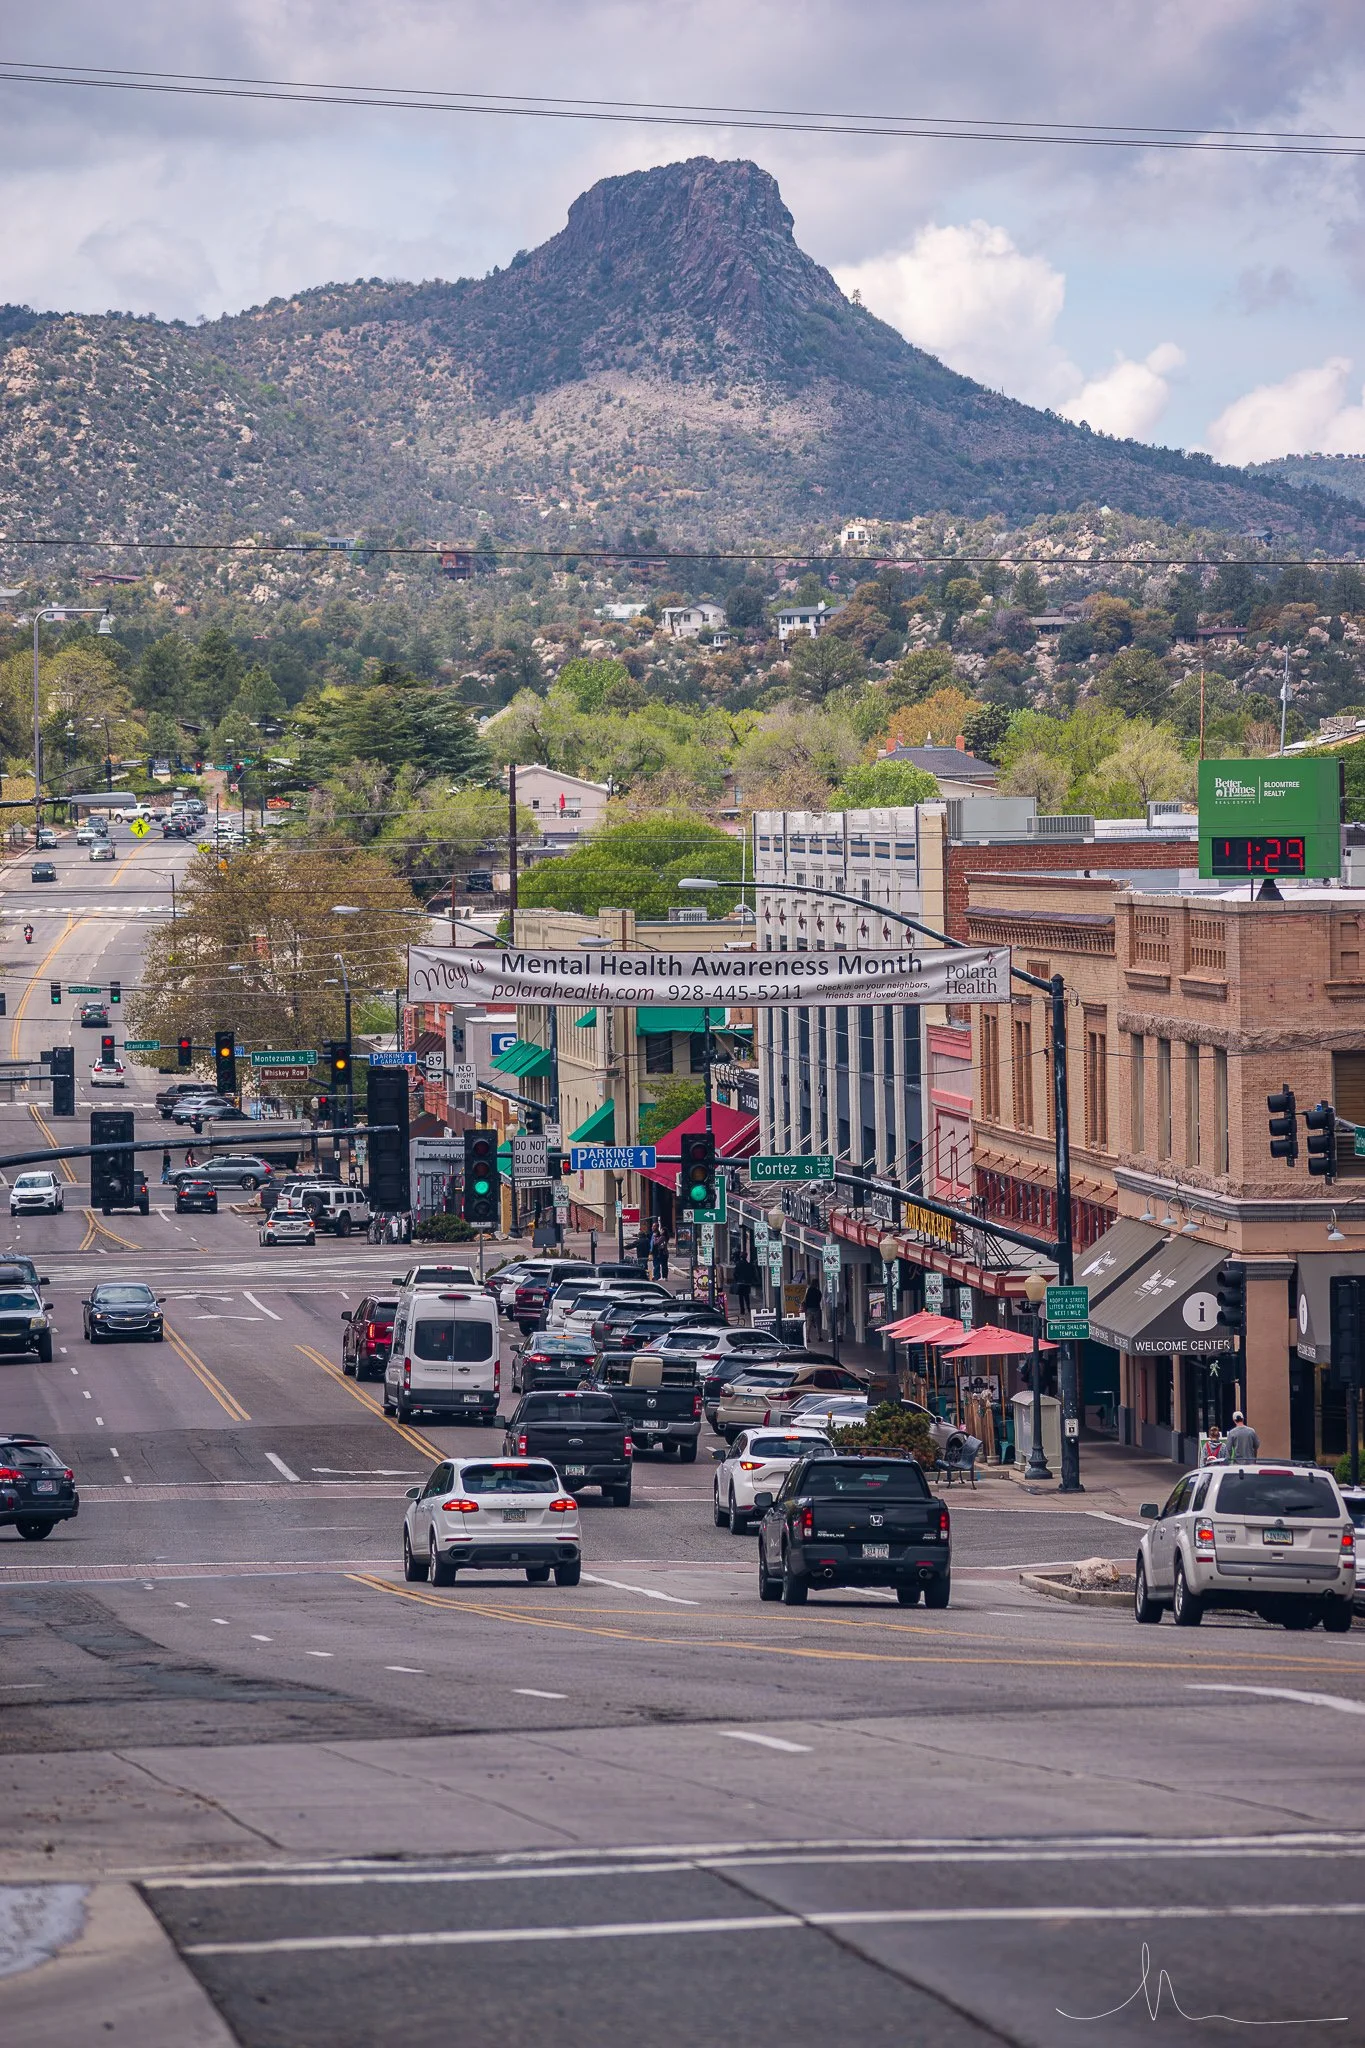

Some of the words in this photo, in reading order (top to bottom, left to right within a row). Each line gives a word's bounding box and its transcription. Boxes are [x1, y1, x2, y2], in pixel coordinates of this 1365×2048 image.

[1215, 778, 1242, 789] Better
[1224, 787, 1256, 797] Homes
[501, 953, 591, 975] Mental
[600, 955, 682, 977] Health
[691, 955, 829, 977] Awareness
[838, 953, 923, 975] Month
[414, 963, 469, 992] May
[471, 959, 487, 975] is
[946, 964, 998, 979] Polara
[491, 981, 655, 1001] polarahealth.com
[668, 985, 803, 1001] 928-445-5211
[816, 983, 842, 991] Check
[866, 982, 886, 991] your
[887, 980, 931, 991] neighbors,
[946, 979, 998, 995] Health
[826, 990, 855, 999] friends
[856, 990, 872, 998] and
[873, 989, 897, 998] loved
[898, 990, 921, 998] ones.
[254, 1054, 296, 1062] Montezuma
[373, 1053, 405, 1065] PARKING
[428, 1056, 443, 1066] 89
[264, 1069, 290, 1078] Whiskey
[515, 1141, 527, 1151] DO
[529, 1140, 546, 1150] NOT
[515, 1154, 546, 1164] BLOCK
[578, 1148, 634, 1168] PARKING
[590, 1158, 634, 1168] GARAGE
[757, 1162, 797, 1175] Cortez
[804, 1166, 814, 1174] St
[1135, 1341, 1187, 1352] WELCOME
[1190, 1340, 1231, 1351] CENTER
